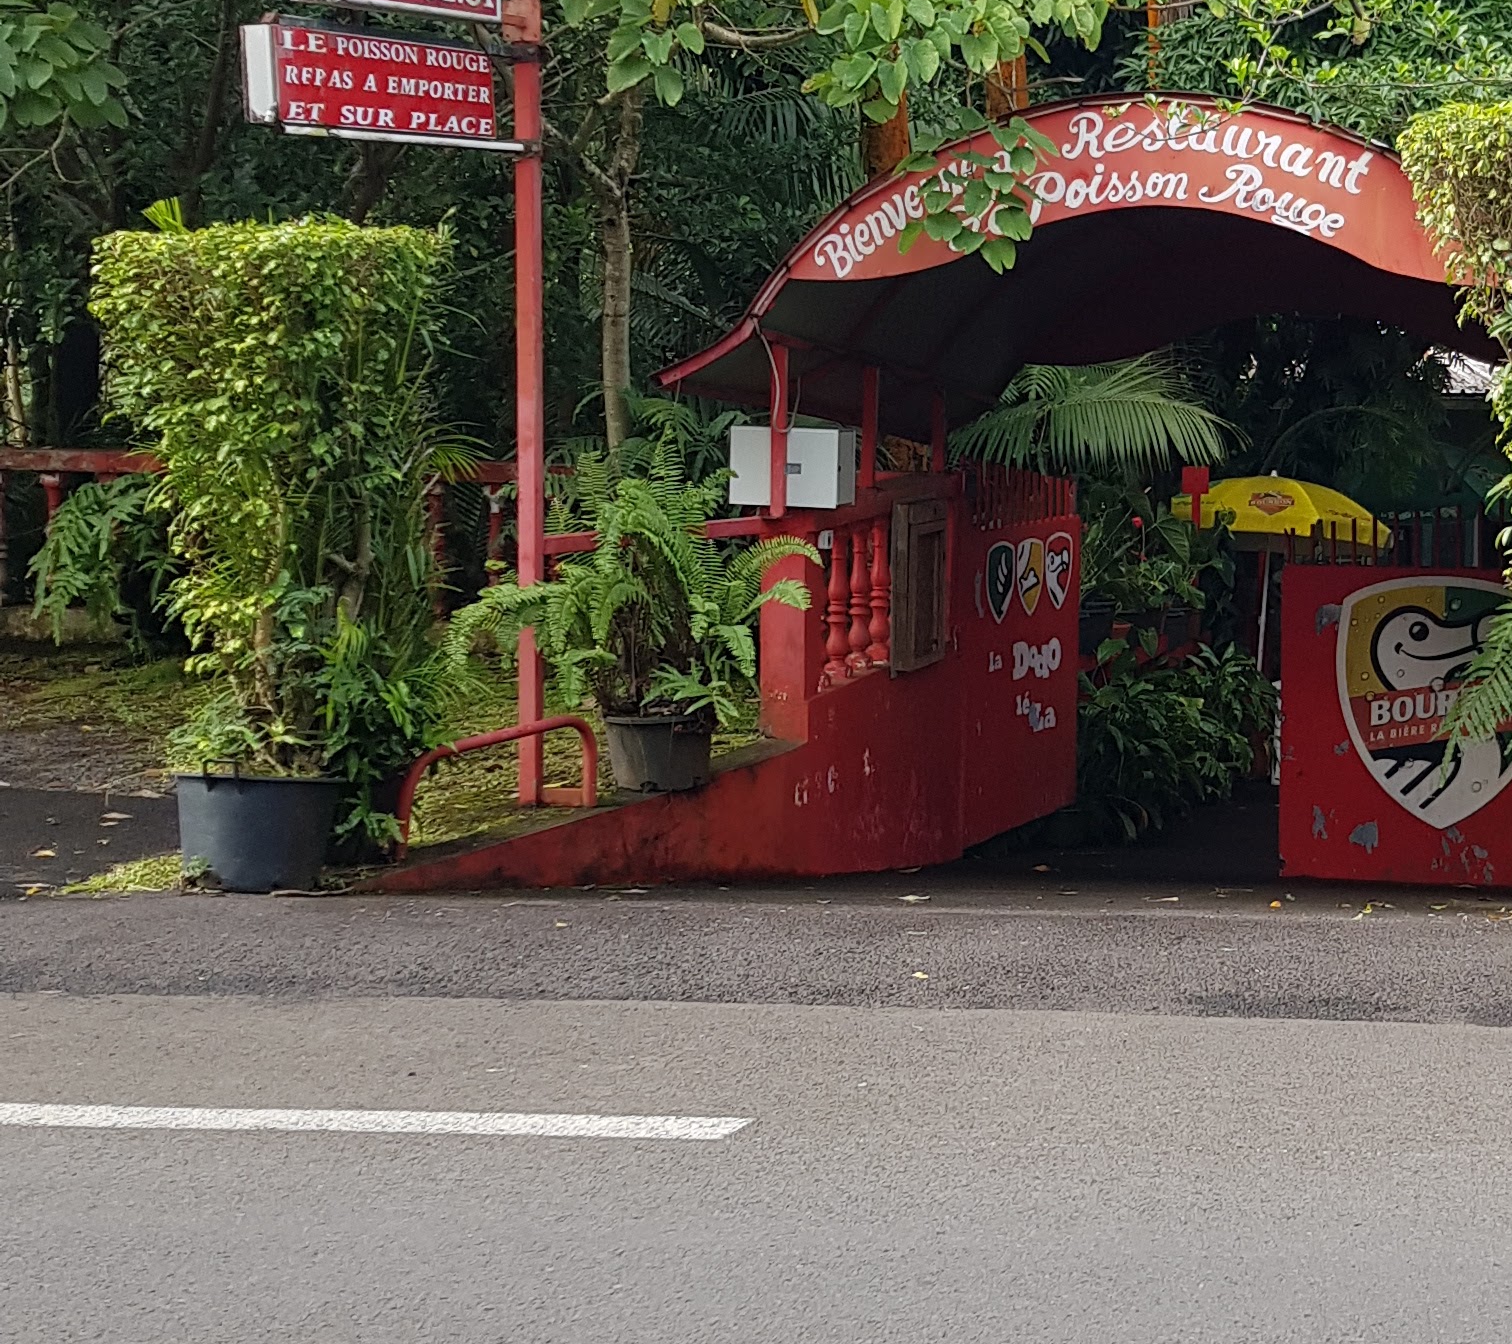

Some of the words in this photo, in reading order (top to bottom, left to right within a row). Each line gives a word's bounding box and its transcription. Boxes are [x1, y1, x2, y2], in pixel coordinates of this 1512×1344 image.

[282, 30, 327, 54] LE
[336, 36, 419, 65] POISSON
[425, 48, 491, 73] ROUGE
[362, 73, 378, 92] A
[386, 76, 491, 104] EMPORTER
[286, 101, 325, 121] ET
[340, 105, 396, 128] SUR
[408, 111, 493, 136] PLACE
[1061, 108, 1374, 195] Restaurant
[1023, 162, 1189, 225] Poisson
[1198, 163, 1346, 238] Rouge
[1370, 730, 1385, 742] LA
[1390, 724, 1425, 739] BIÈRE
